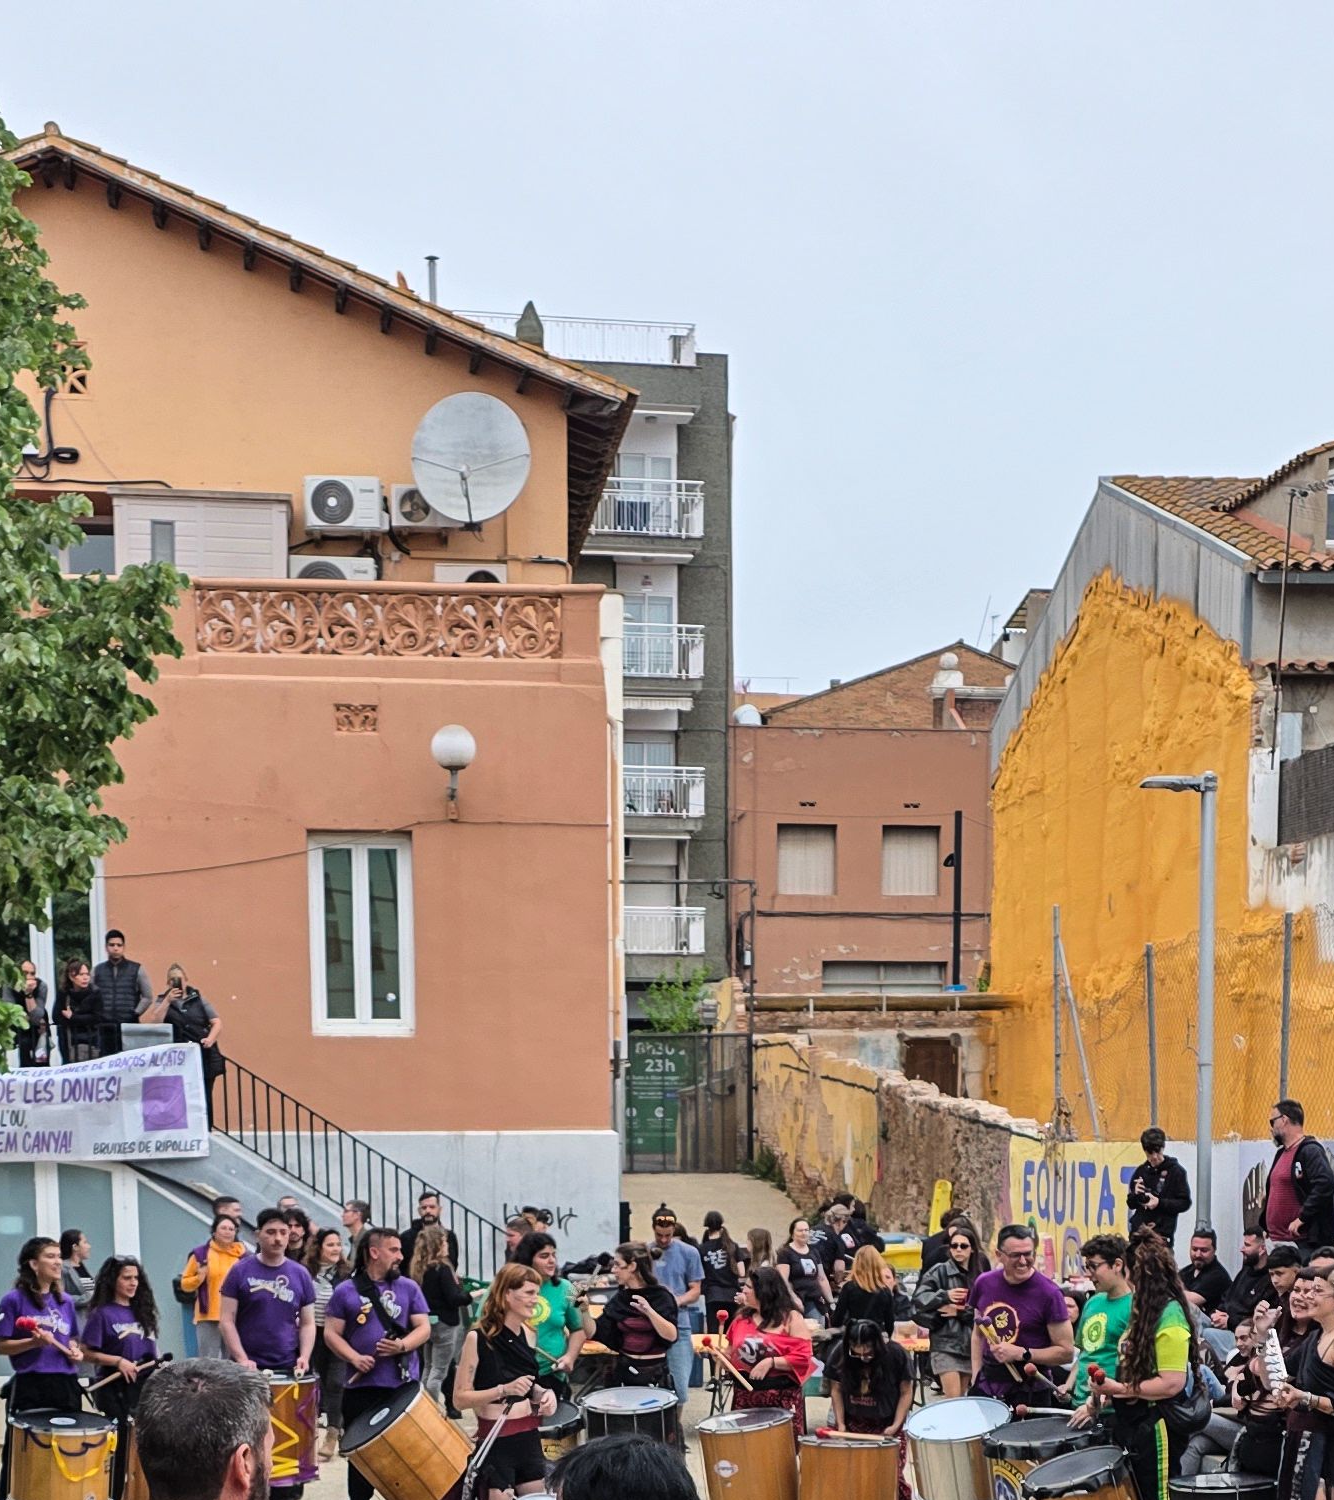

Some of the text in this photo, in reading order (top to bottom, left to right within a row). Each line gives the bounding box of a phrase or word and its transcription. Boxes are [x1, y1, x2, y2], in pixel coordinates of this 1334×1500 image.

[645, 1058, 676, 1072] 23h
[23, 1078, 55, 1104] LES
[61, 1076, 122, 1103] DONES!
[22, 1130, 73, 1154] CANYA!
[93, 1139, 204, 1155] BRUIXES DE RIPOLLET
